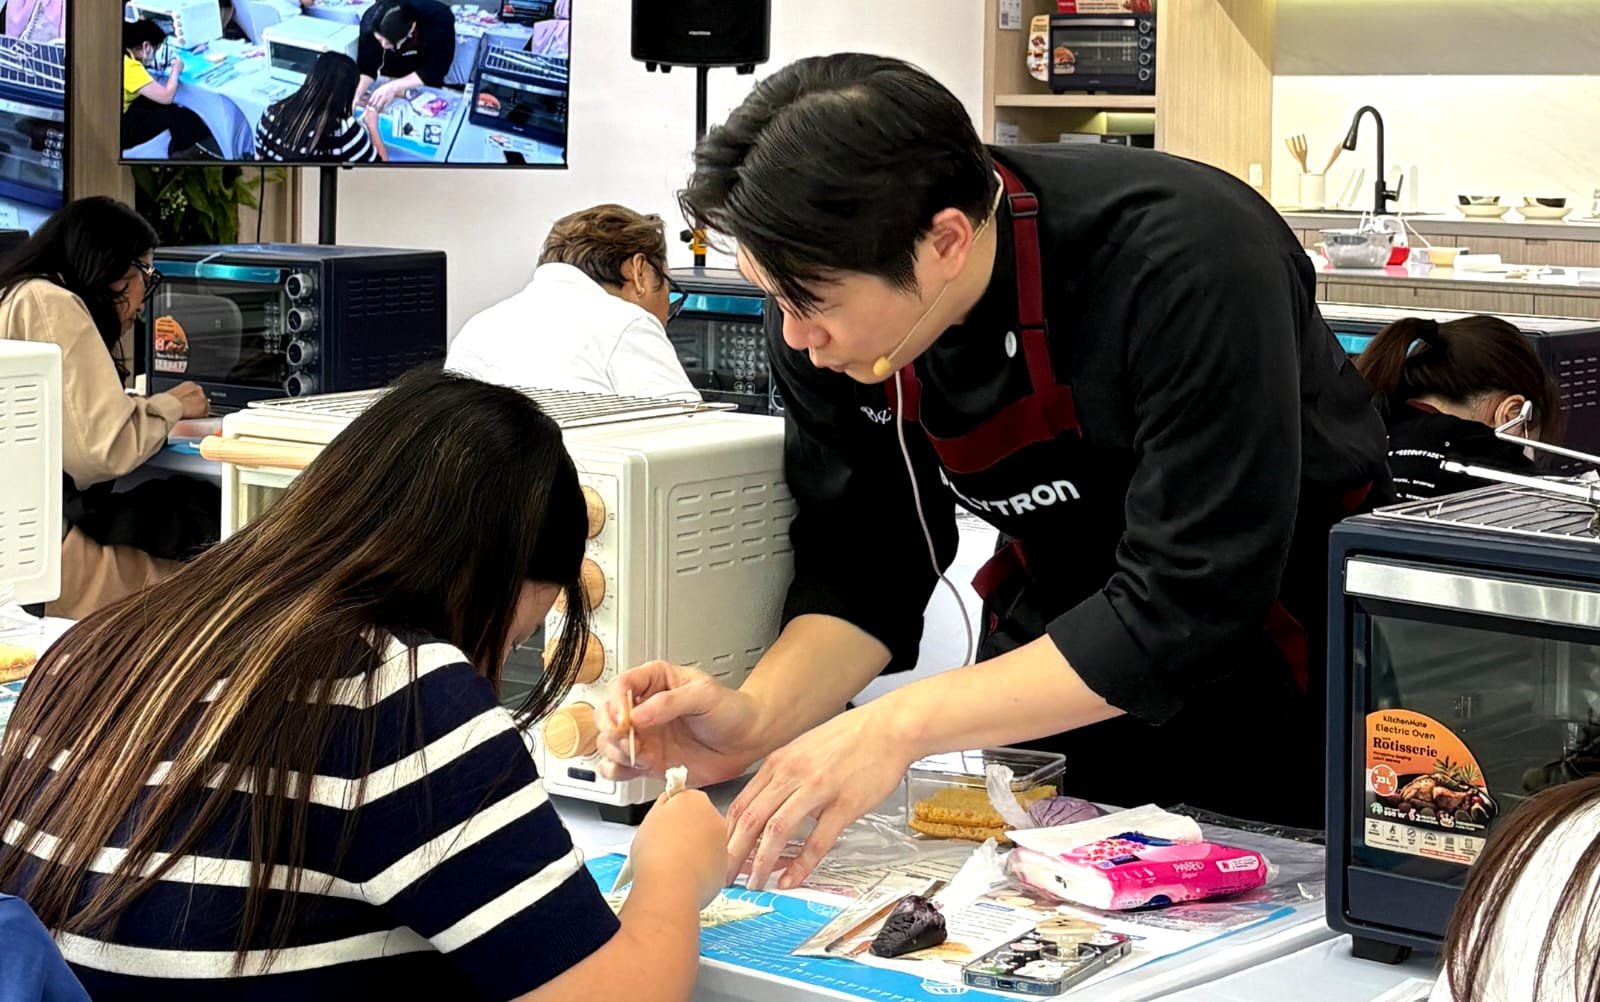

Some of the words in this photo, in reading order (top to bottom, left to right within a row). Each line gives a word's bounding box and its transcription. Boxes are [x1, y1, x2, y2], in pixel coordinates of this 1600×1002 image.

[1376, 723, 1410, 736] Electric
[1412, 729, 1436, 740] Oven
[1373, 737, 1438, 758] Rotisserie
